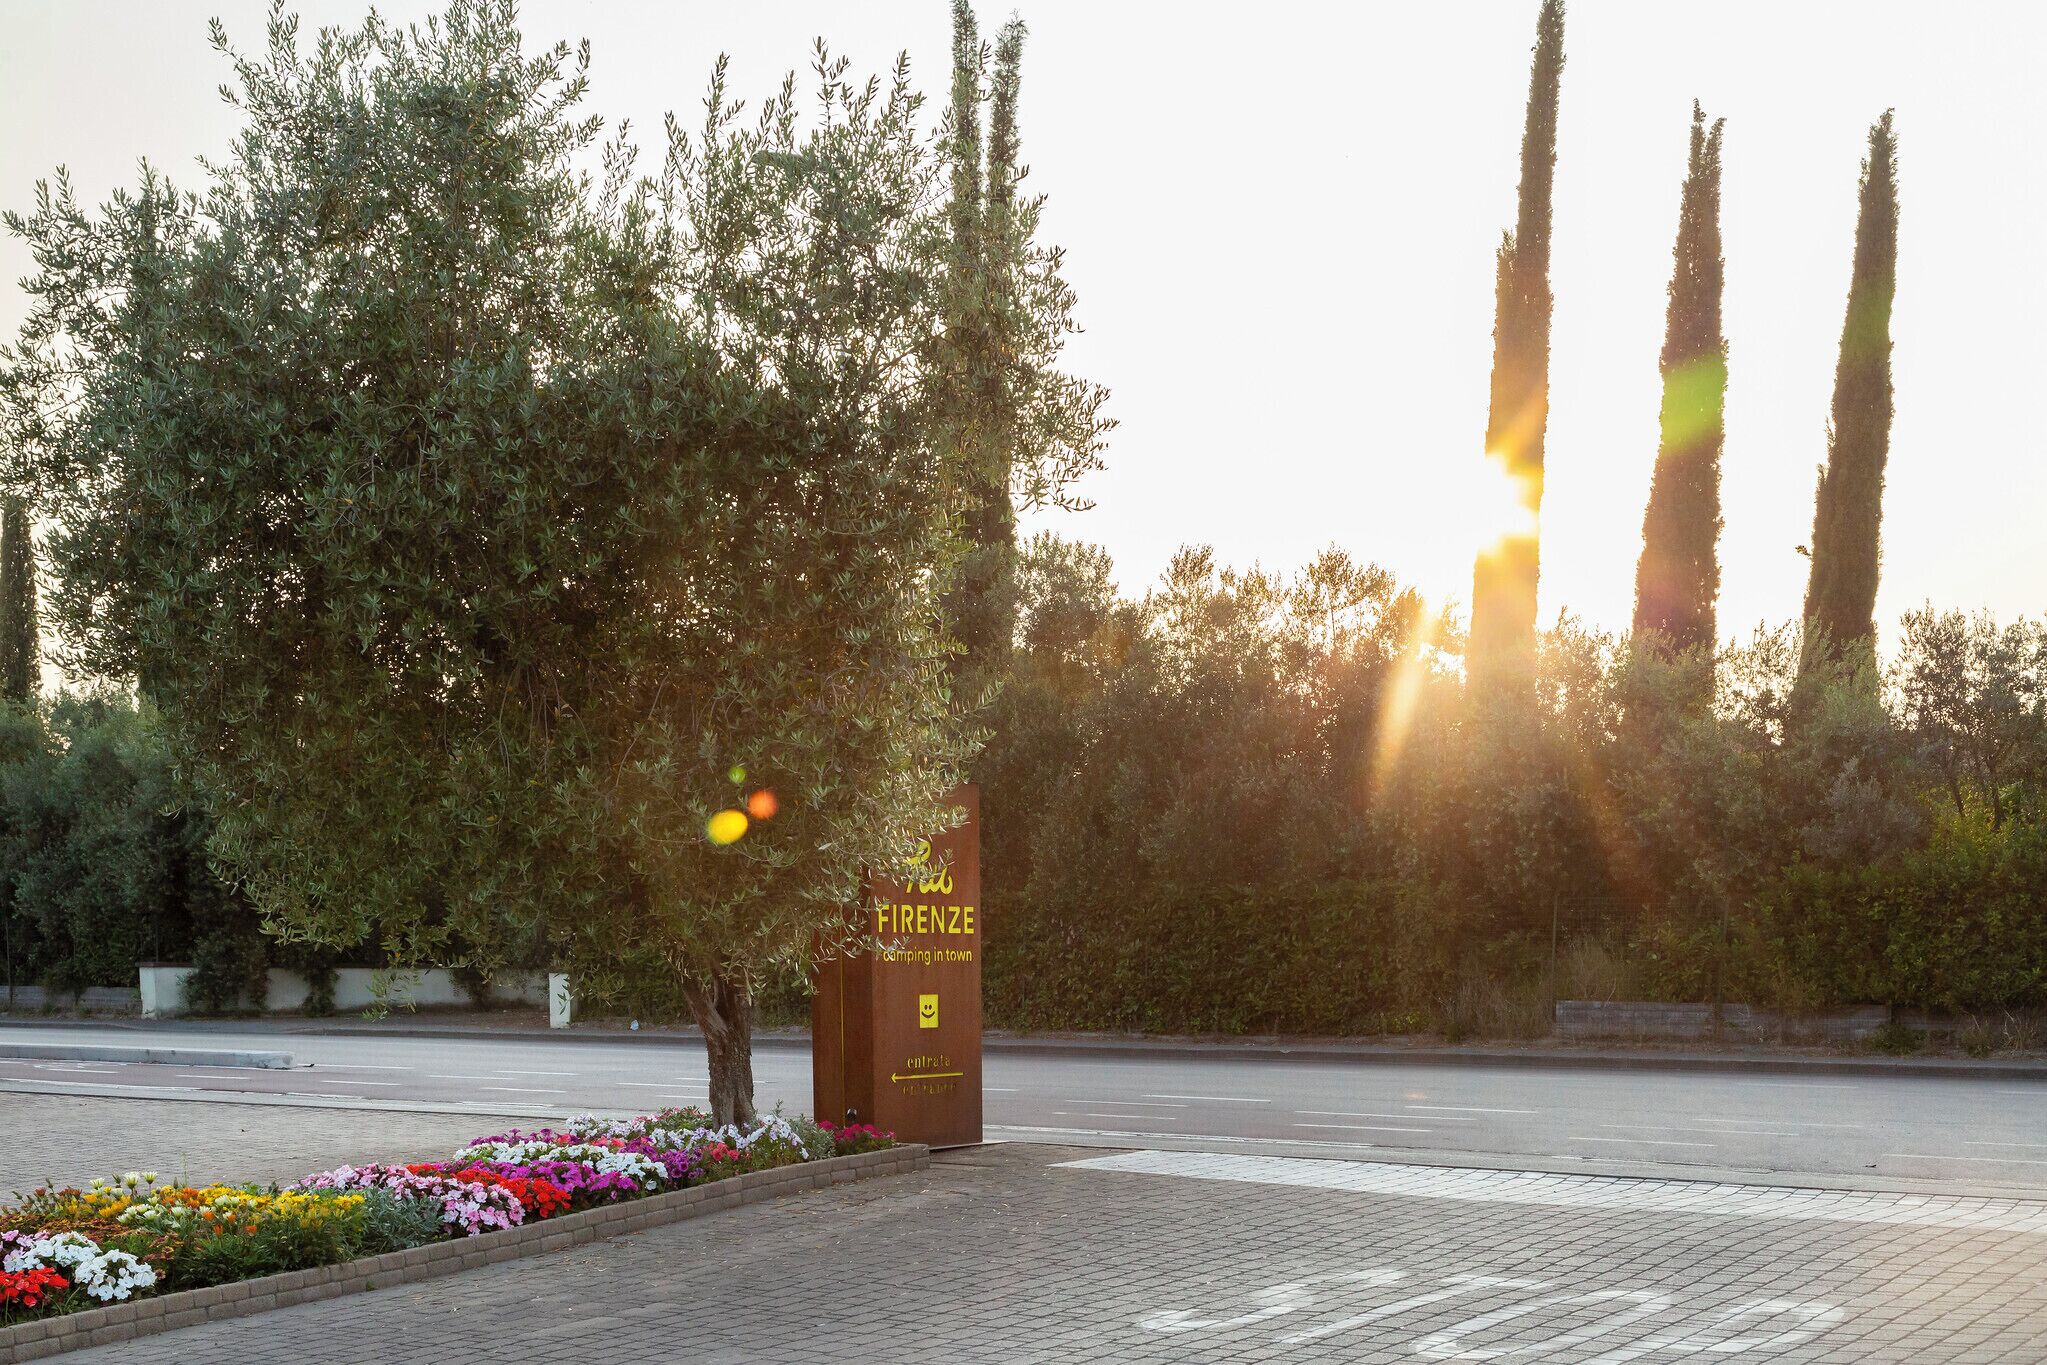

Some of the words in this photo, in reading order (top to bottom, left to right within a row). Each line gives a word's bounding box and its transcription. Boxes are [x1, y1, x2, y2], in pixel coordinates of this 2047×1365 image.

[878, 904, 975, 935] FIRENZE
[883, 947, 931, 966] camping
[934, 946, 944, 962] in
[945, 948, 973, 962] town
[907, 1054, 951, 1069] entrata
[1138, 1267, 1847, 1365] STOP
